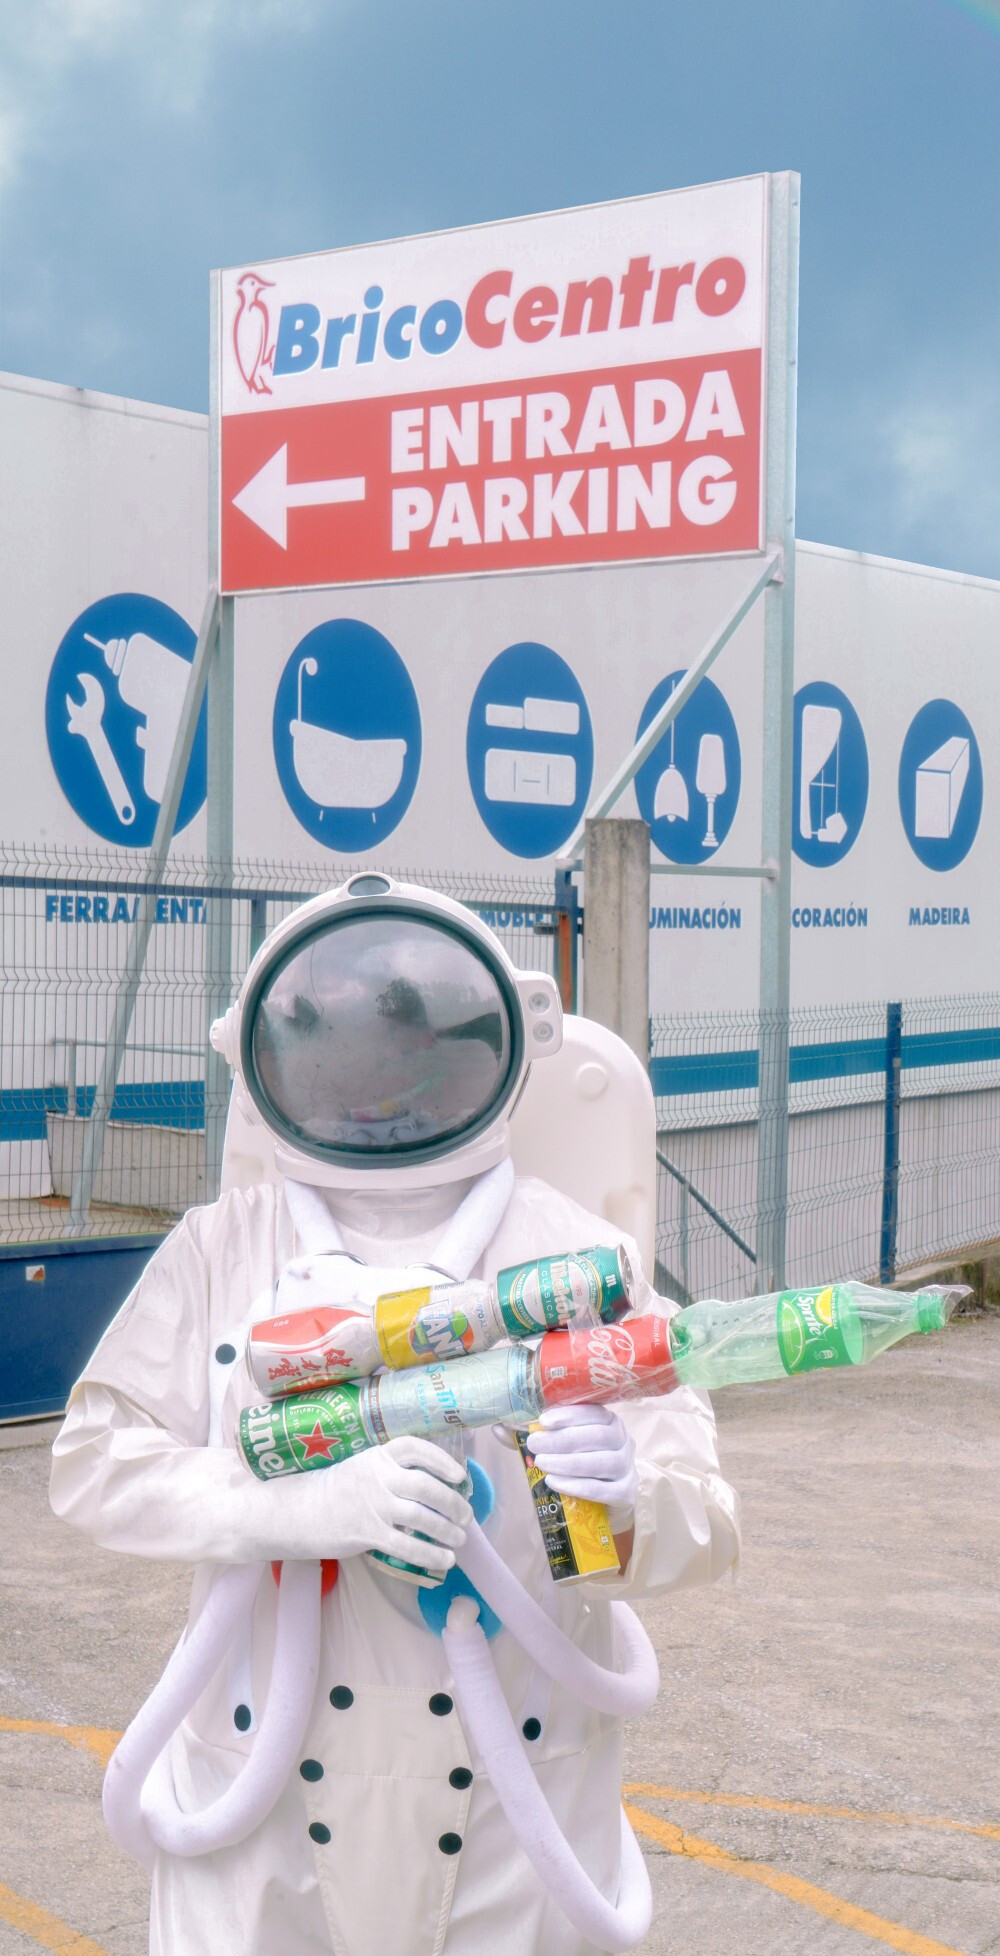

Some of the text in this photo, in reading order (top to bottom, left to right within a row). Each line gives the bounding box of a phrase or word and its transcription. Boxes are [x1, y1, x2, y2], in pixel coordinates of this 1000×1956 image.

[272, 254, 747, 377] BricoCentro
[390, 369, 745, 474] ENTRADA
[391, 454, 737, 551] PARKING
[46, 895, 207, 924] FERRAENT
[909, 907, 971, 926] MADEIRA
[541, 1270, 554, 1319] CLÁSICA
[797, 1296, 823, 1335] Sprite
[587, 1325, 640, 1388] Cola
